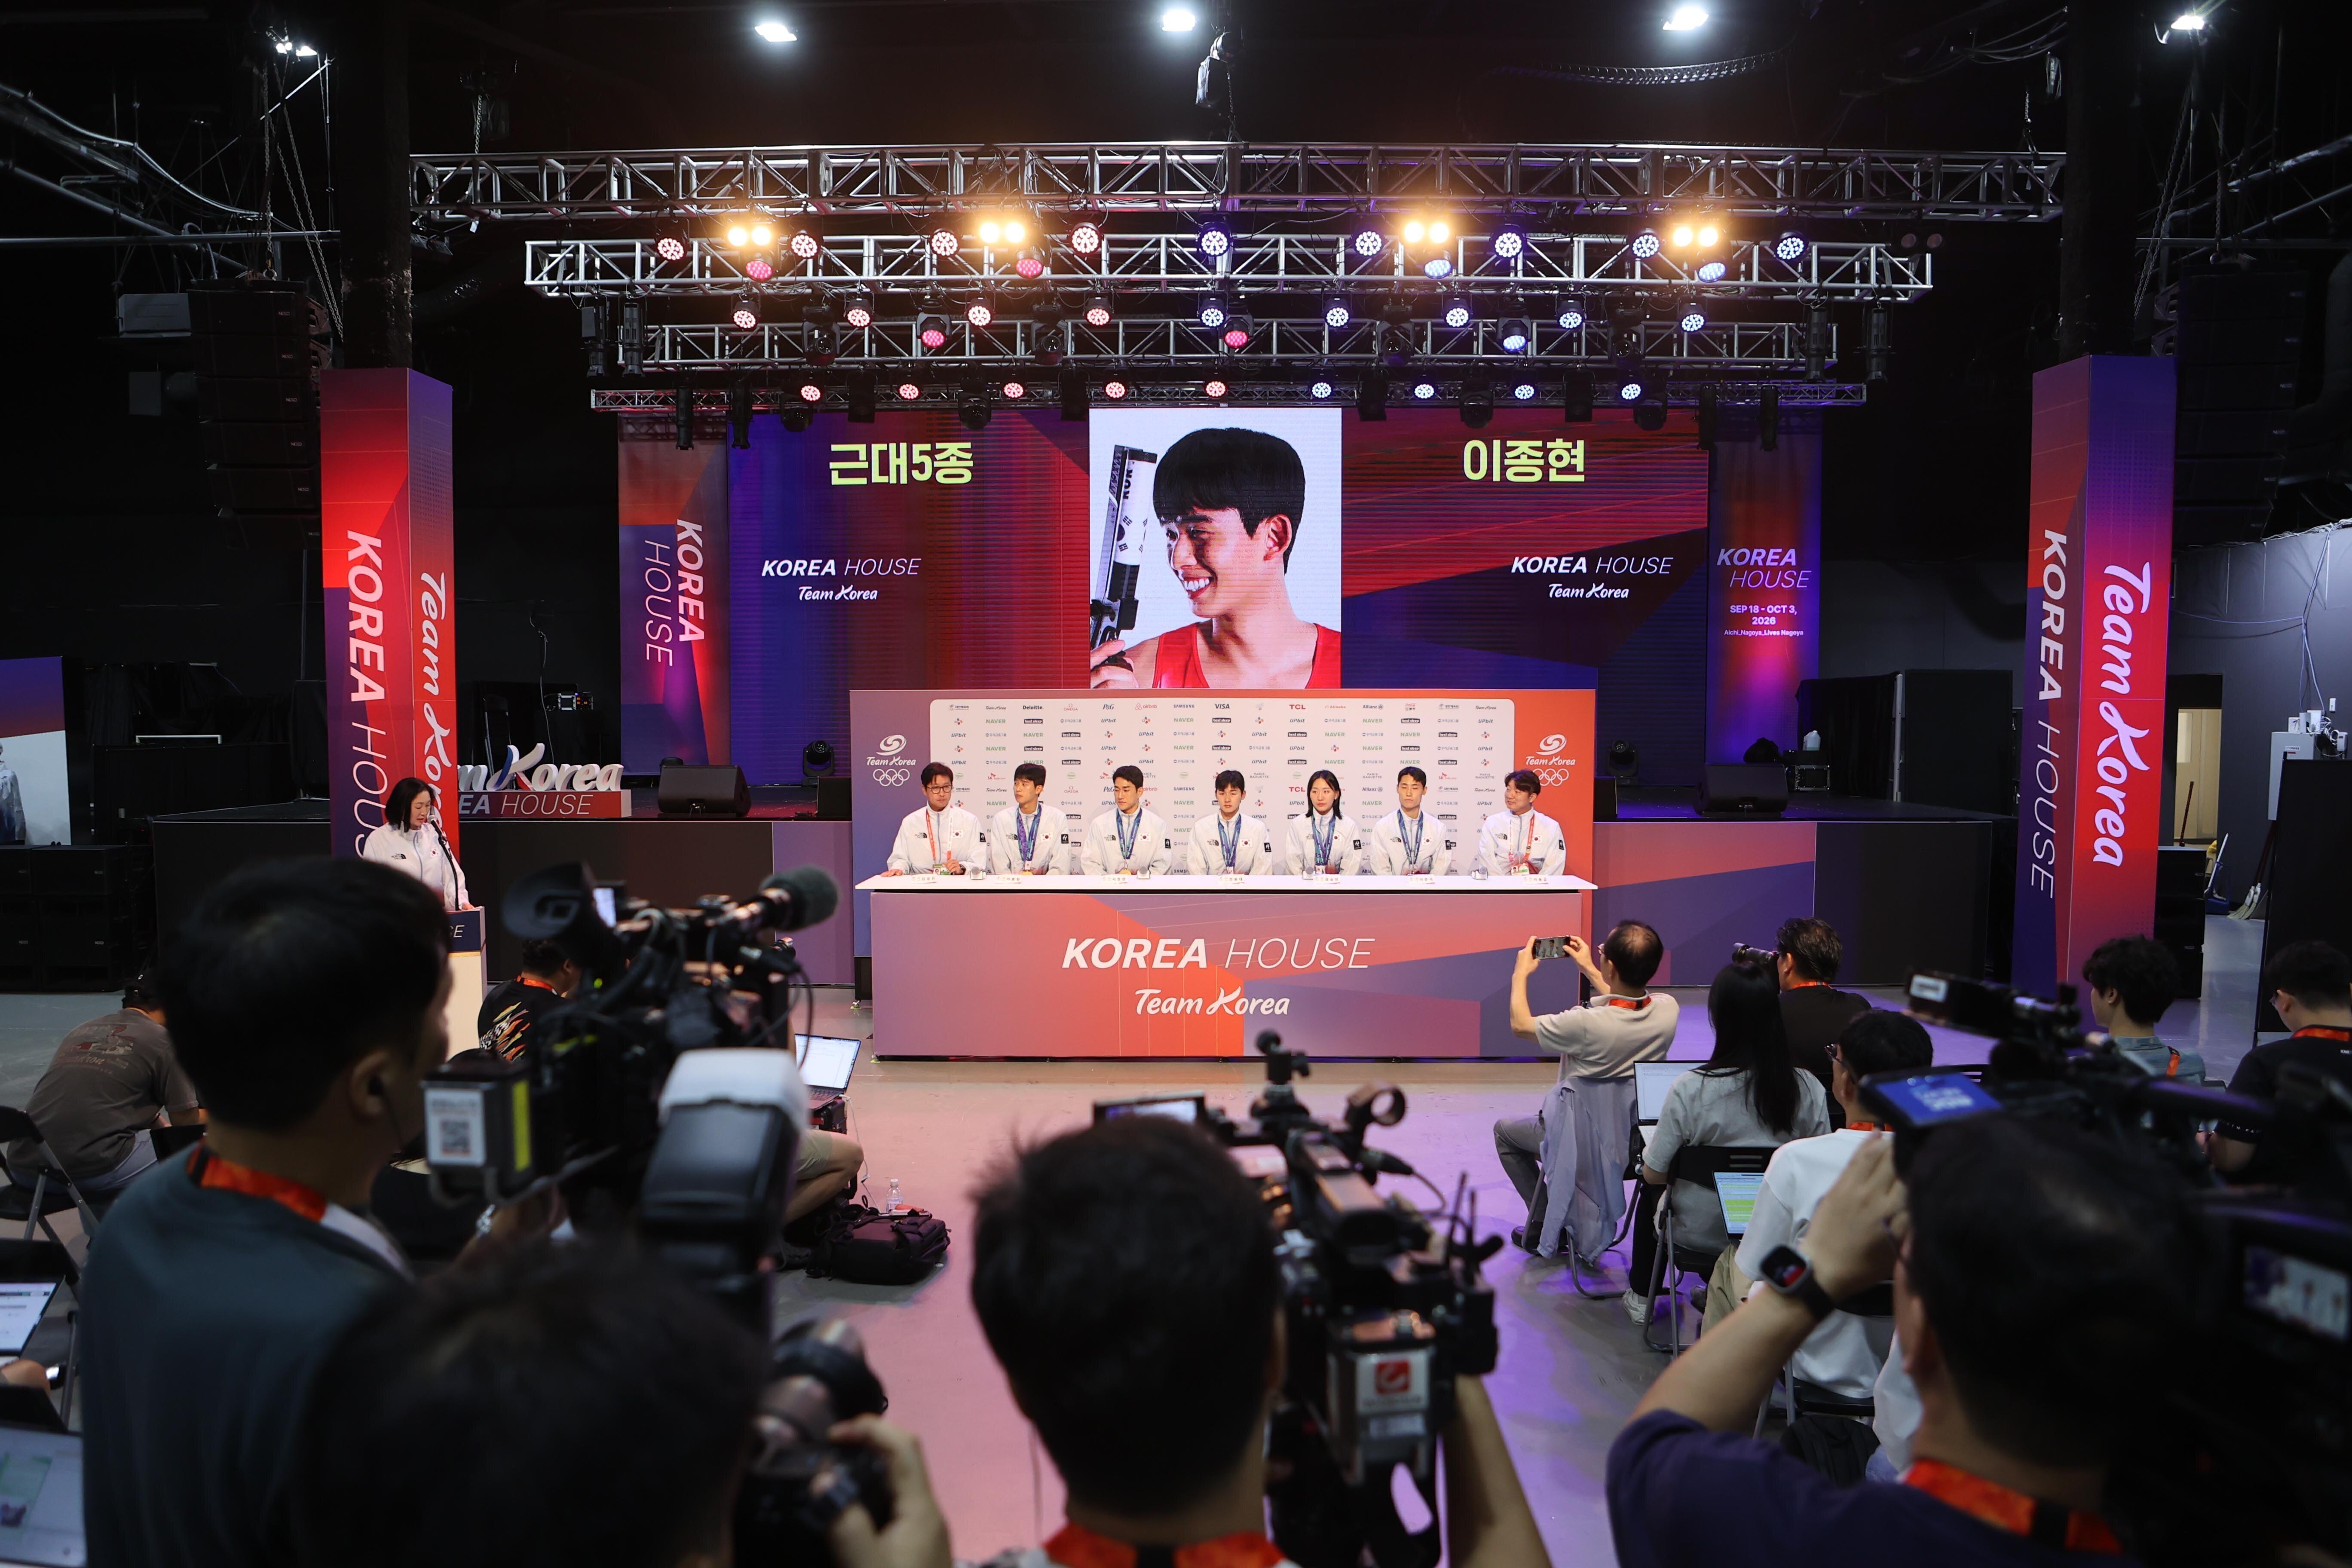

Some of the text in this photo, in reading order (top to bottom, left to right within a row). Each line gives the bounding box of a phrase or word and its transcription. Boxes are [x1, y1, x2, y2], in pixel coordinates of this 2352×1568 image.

[830, 442, 973, 485] 근대5종
[1464, 438, 1584, 482] 이종현
[762, 558, 921, 576] KOREA HOUSE
[1512, 557, 1673, 573] KOREA HOUSE
[1717, 548, 1795, 566] KOREA
[677, 519, 704, 641] KOREA
[799, 585, 877, 600] Team Korea
[1549, 583, 1629, 598] Team Korea
[1730, 571, 1811, 588] HOUSE
[645, 540, 672, 666] HOUSE
[1789, 605, 1797, 615] 3,
[421, 573, 445, 695] Team
[348, 531, 388, 858] KOREA HOU
[2032, 530, 2066, 898] KOREA HOUSE
[2093, 562, 2150, 866] Team Korea
[486, 743, 624, 791] Korea
[867, 756, 916, 766] Team Korea
[1526, 756, 1575, 765] Team Korea
[502, 795, 593, 814] HOUSE
[1063, 938, 1375, 968] KOREA HOUSE
[1136, 986, 1289, 1014] Team Korea
